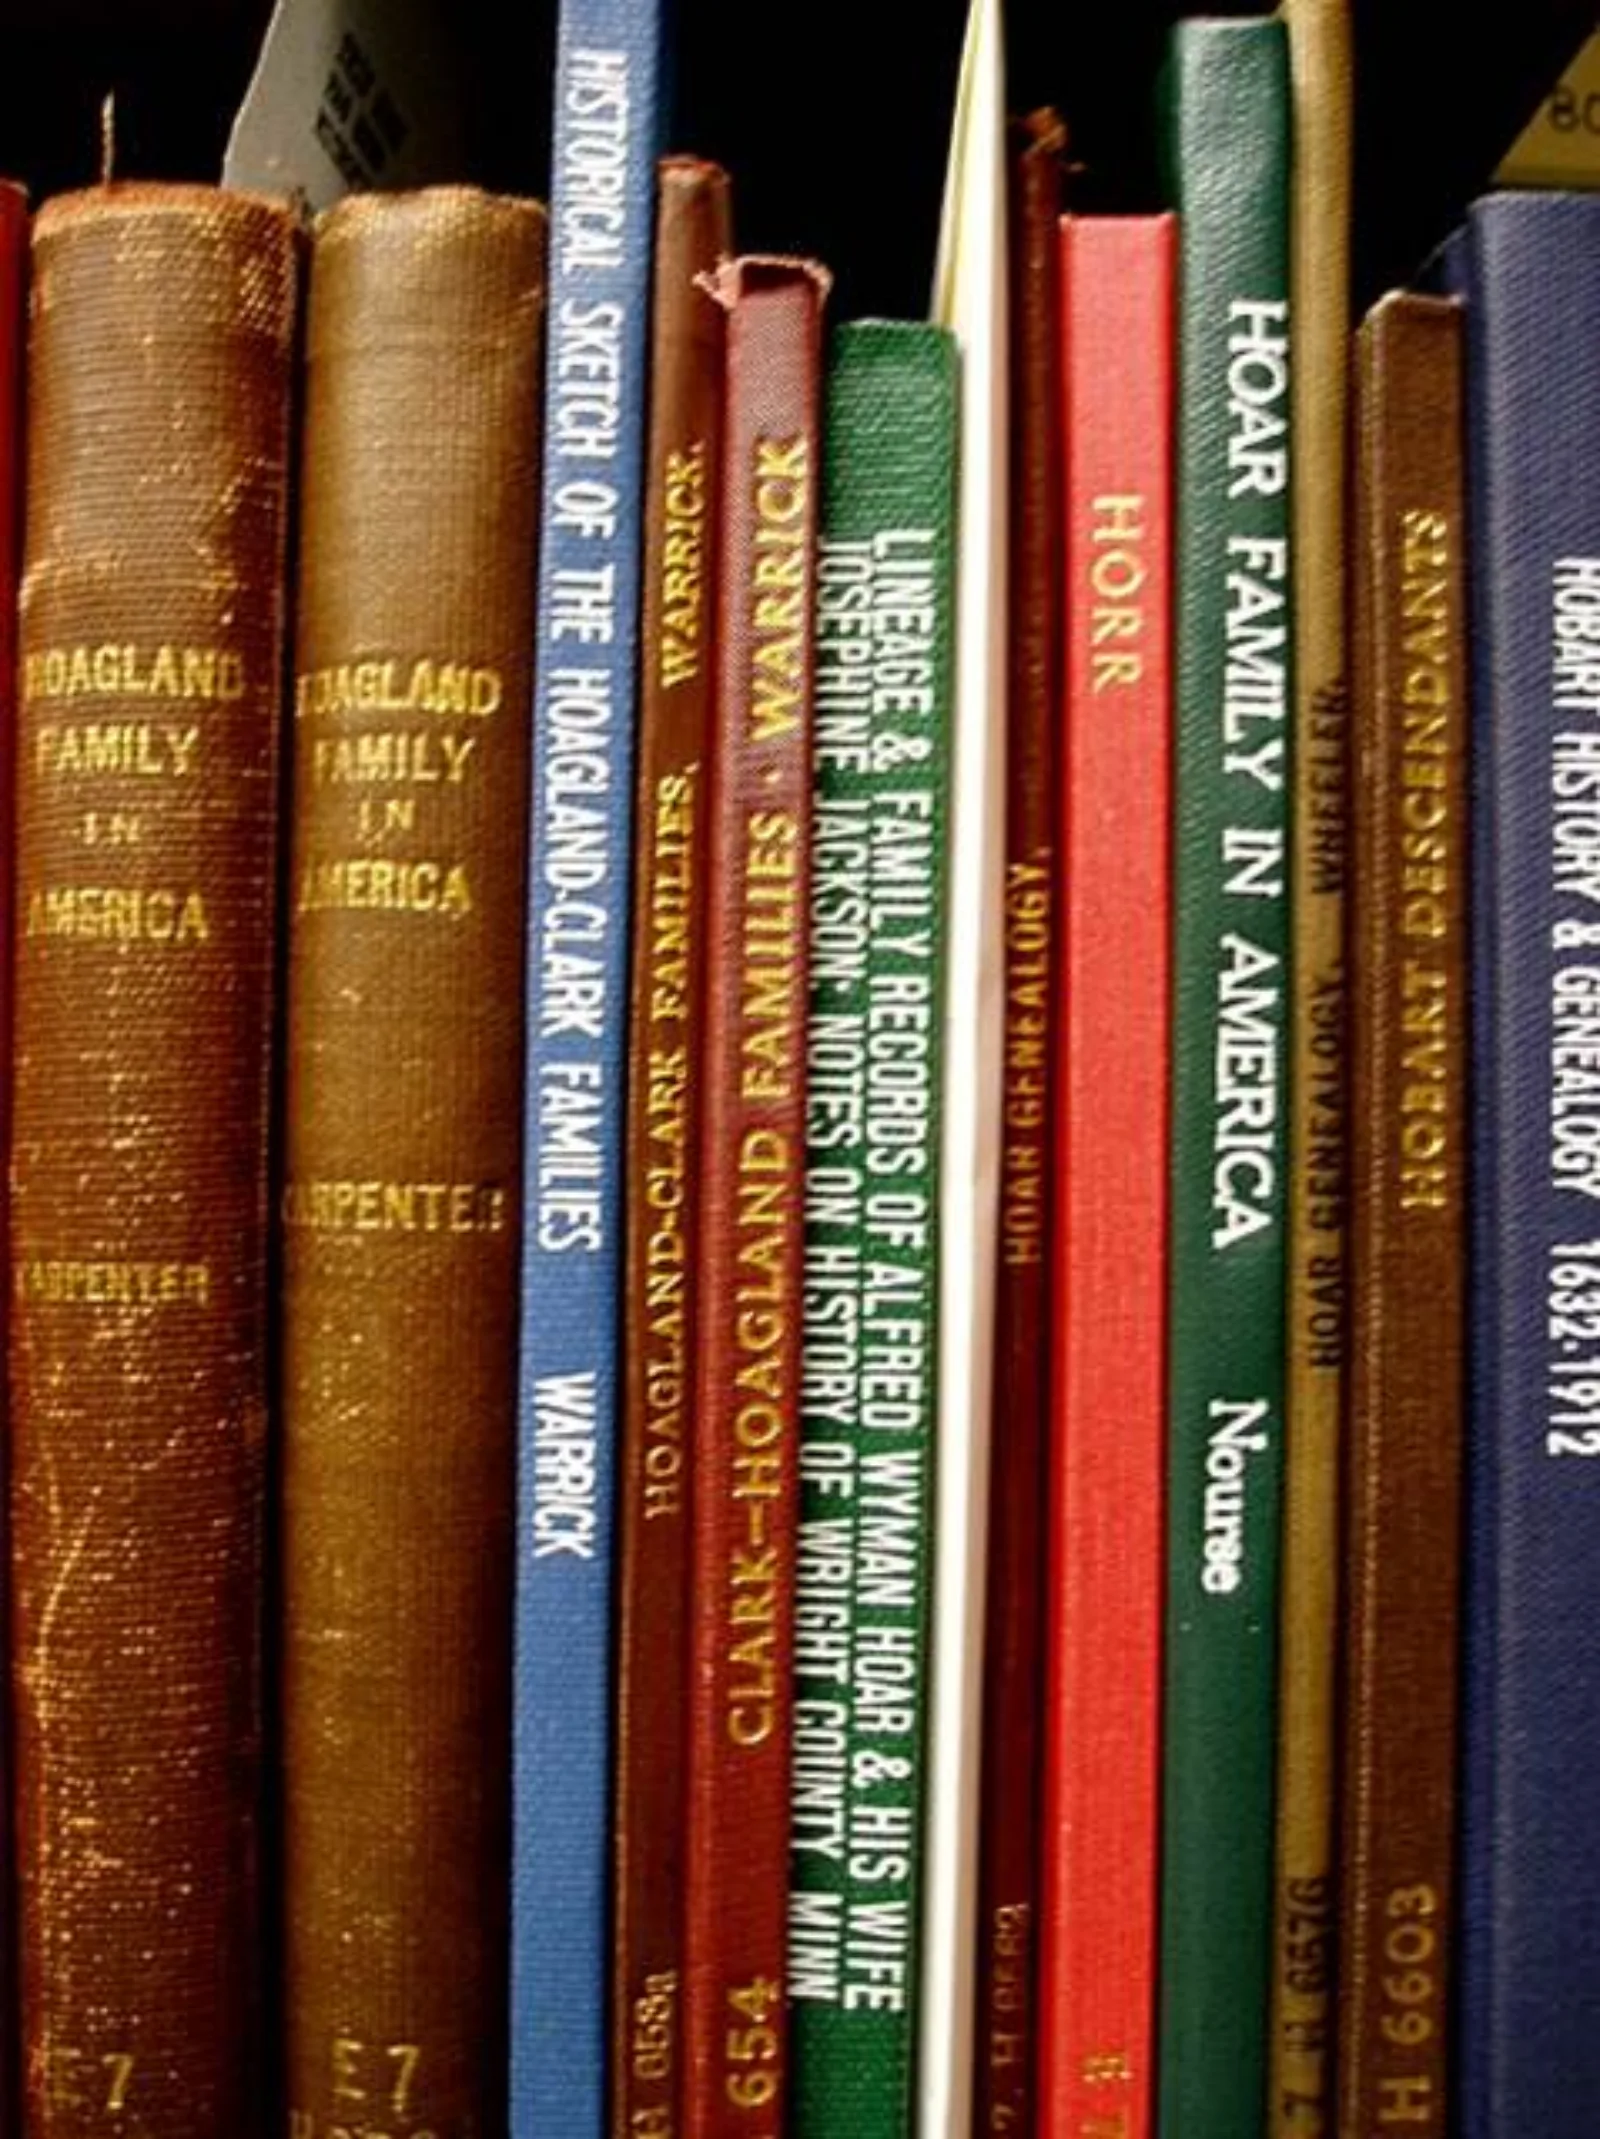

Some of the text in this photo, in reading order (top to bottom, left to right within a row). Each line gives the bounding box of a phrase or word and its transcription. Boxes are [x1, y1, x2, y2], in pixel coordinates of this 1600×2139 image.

[750, 437, 810, 743] WARRICK
[814, 538, 875, 774] JOSEPHINE
[1090, 494, 1147, 694] HORR
[1552, 558, 1600, 717] HOBART
[36, 724, 199, 777] FAMILY
[313, 733, 476, 787] FAMILY
[532, 48, 630, 1559] HISTORICAL SKETCH OF THE HOAGLAND-CLARK FAMILIES WARRICK
[1552, 732, 1600, 906] HISTORY
[1399, 508, 1449, 1209] HOBART DESCENDANTS
[742, 810, 798, 1102] FAMILIES
[1201, 300, 1288, 1594] HOAR FAMILY IN AMERICA Nourse
[806, 1014, 866, 1149] NOTES
[1551, 965, 1600, 1199] GENEALOGY
[642, 1044, 689, 1520] HOAGLAND-CLARK
[804, 1166, 864, 1226] ON
[842, 527, 939, 2013] LINEAGE & FAMILY RECORDS OF ALFRED WYMAN HOAR & HIS WIFE
[799, 1245, 862, 1426] HISTORY
[798, 1441, 857, 1499] OF
[792, 1518, 854, 1687] WRIGHT
[788, 1698, 847, 1860] COUNTY
[785, 1892, 845, 2001] MINN
[1378, 1882, 1436, 2123] H 6603
[101, 2053, 135, 2110] 7
[387, 2044, 420, 2112] 7
[725, 1974, 781, 2108] 654
